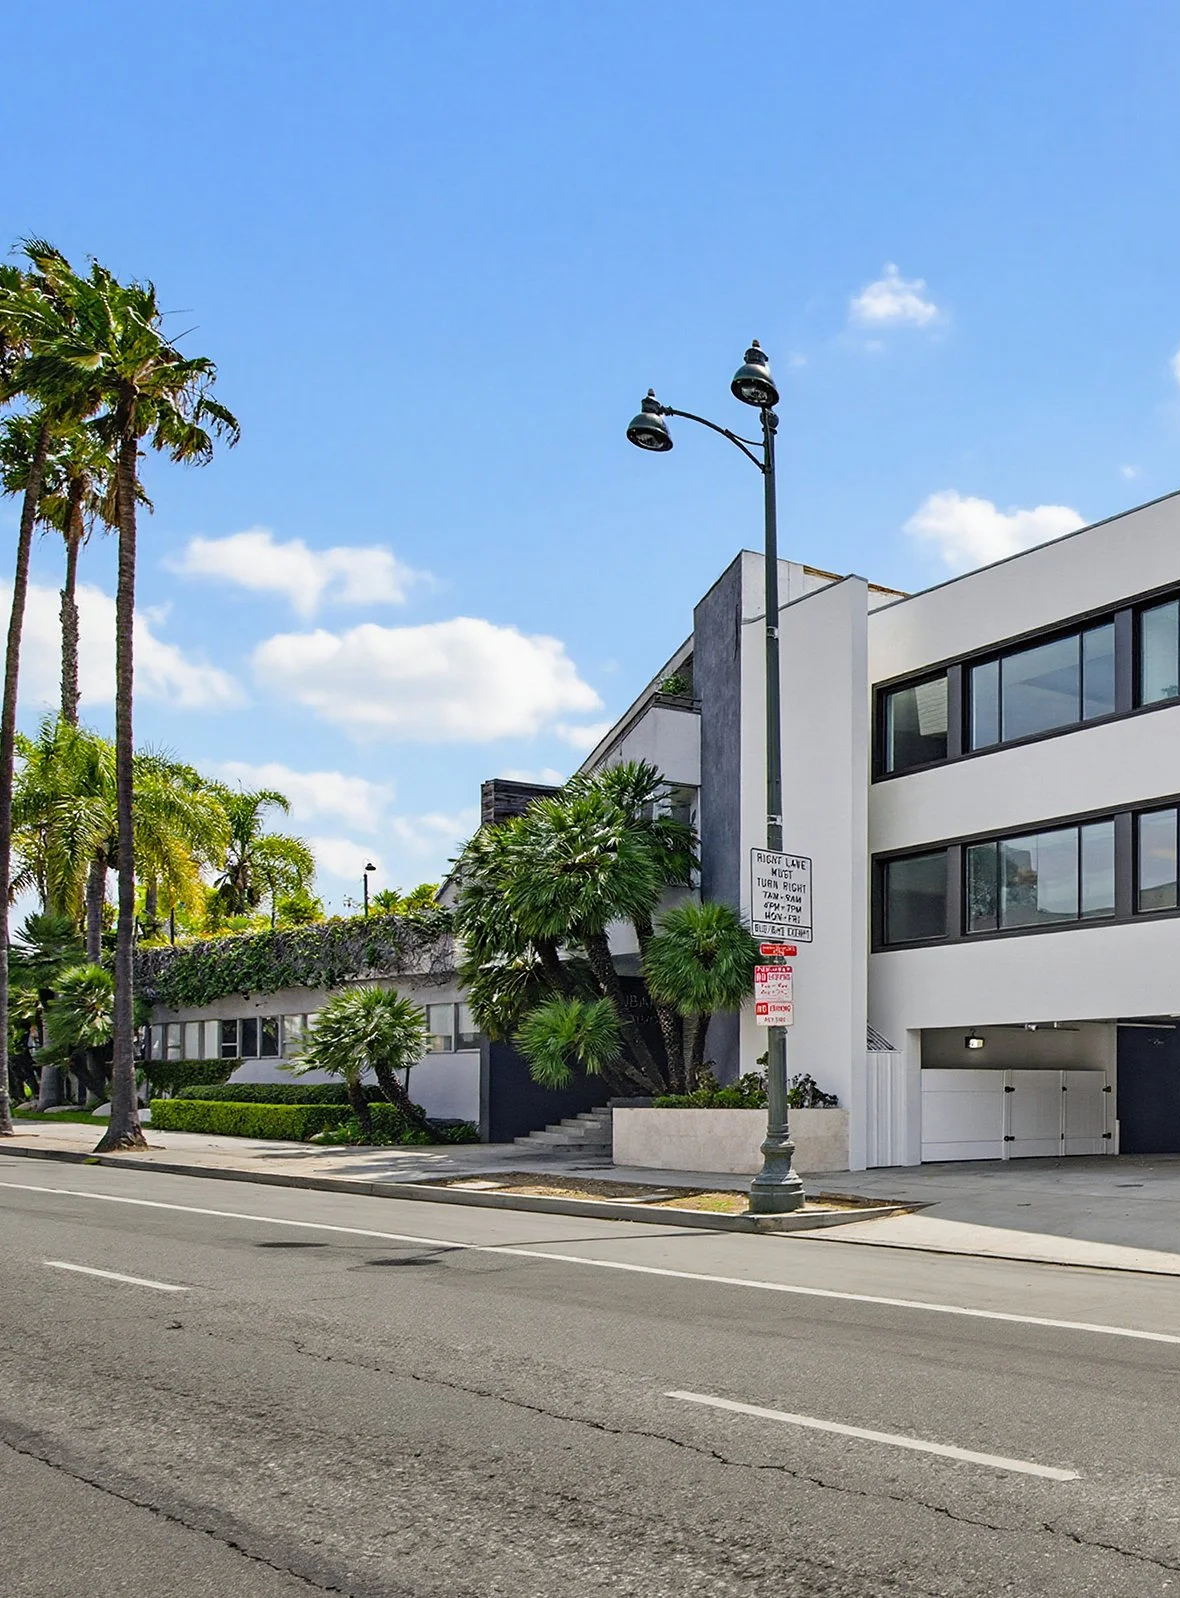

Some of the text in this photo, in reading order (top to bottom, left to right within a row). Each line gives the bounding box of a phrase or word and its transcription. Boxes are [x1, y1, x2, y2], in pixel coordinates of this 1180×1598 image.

[757, 852, 807, 870] RIGHT LANE
[771, 867, 793, 880] MUST
[757, 877, 806, 894] TURN RIGHT
